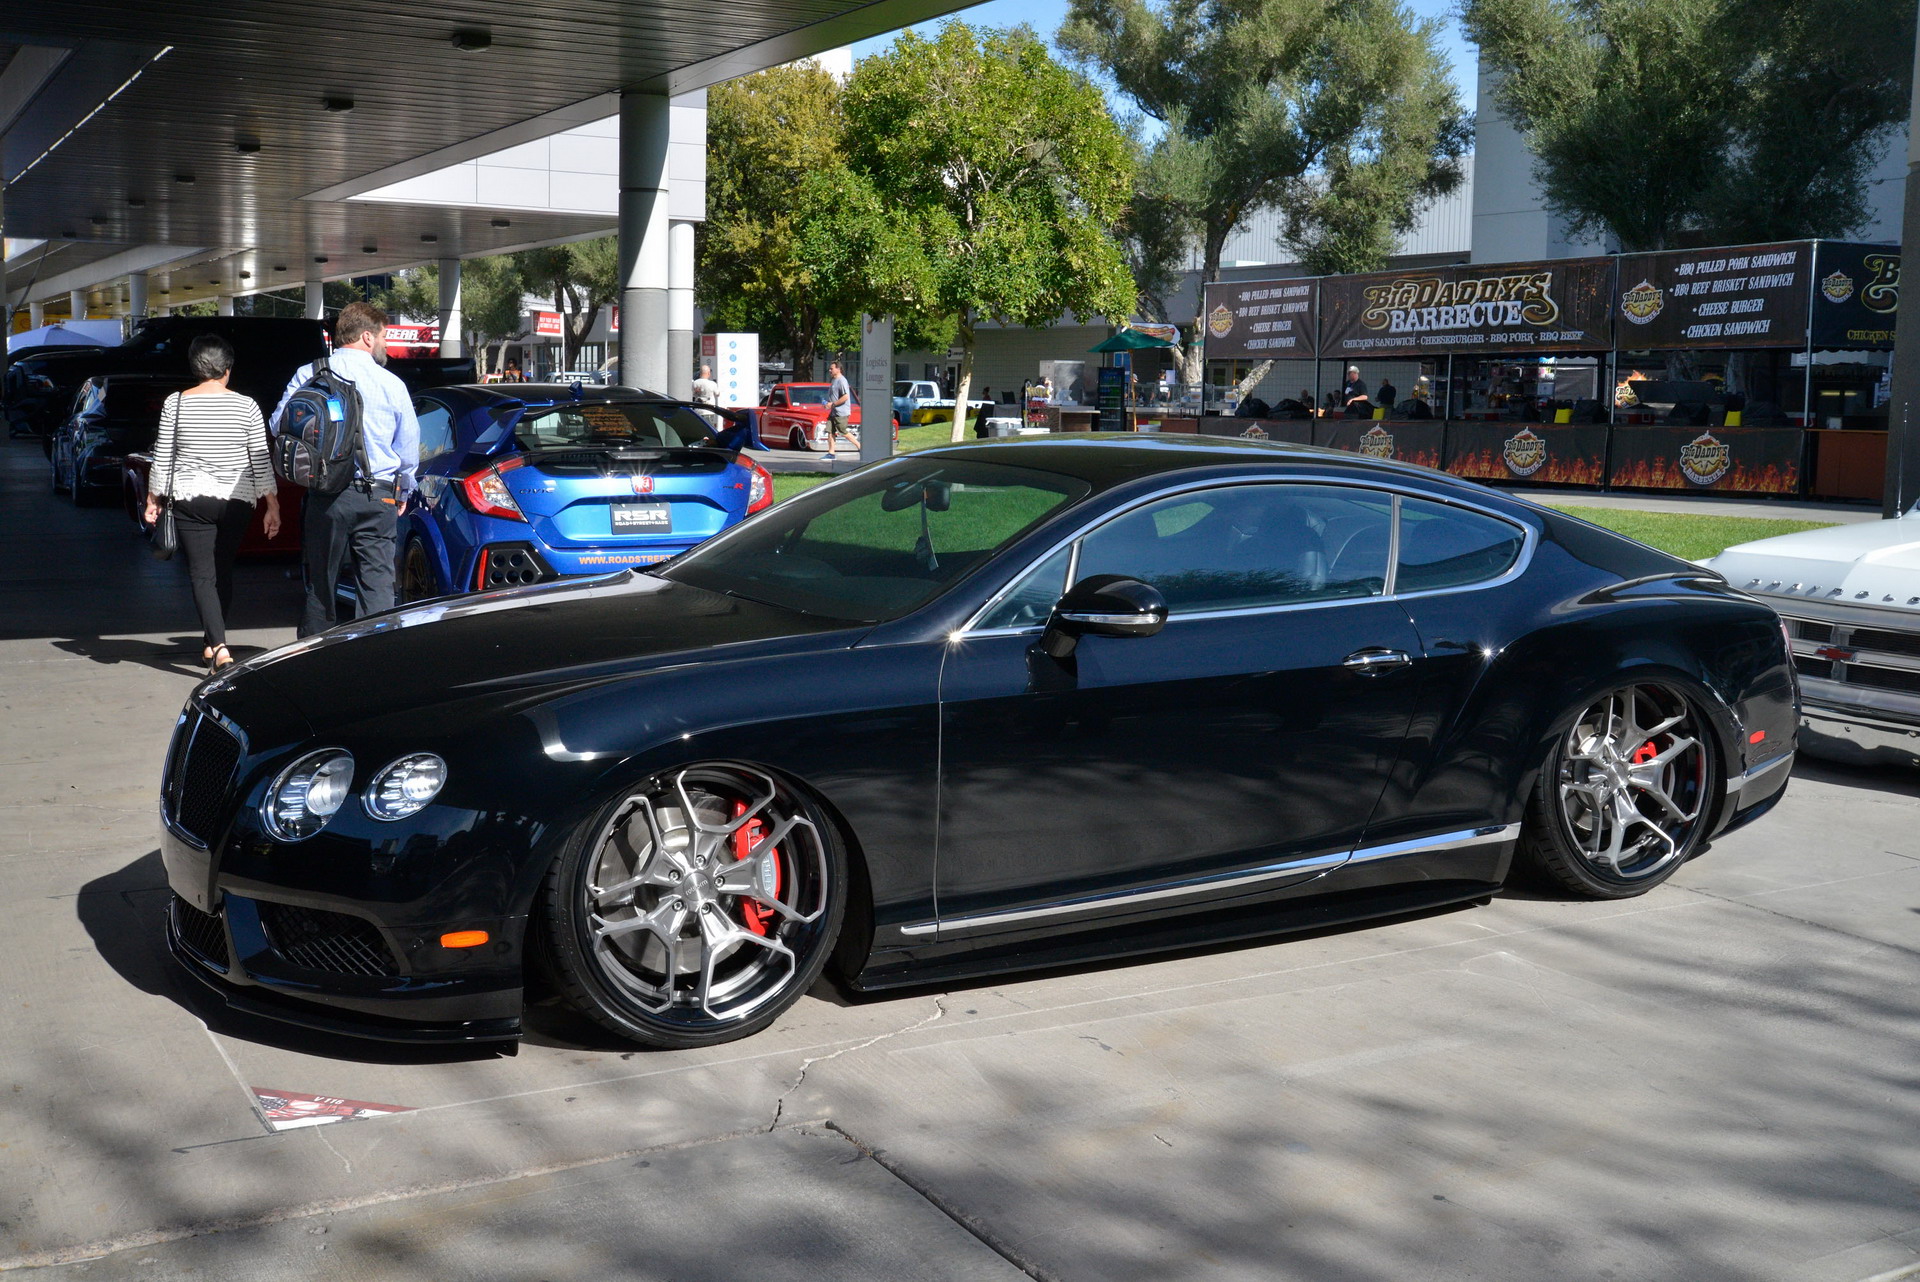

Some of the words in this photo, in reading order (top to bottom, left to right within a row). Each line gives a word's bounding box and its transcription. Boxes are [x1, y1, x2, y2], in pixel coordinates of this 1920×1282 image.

[1679, 262, 1694, 276] BBQ
[1696, 259, 1727, 274] PULLED
[1727, 256, 1751, 271] PORK
[1751, 251, 1797, 268] SANDWICH
[1251, 289, 1269, 300] PULLED
[1269, 288, 1283, 299] PORK
[1283, 285, 1310, 297] SANDWICH
[1674, 282, 1690, 297] BBQ
[1691, 281, 1711, 295] BEEF
[1712, 277, 1748, 294] BRISKET
[1748, 272, 1795, 290] SANDWICH
[1282, 301, 1309, 313] SANDWICH
[1698, 302, 1729, 316] CHEESE
[1730, 298, 1764, 314] BURGER
[1389, 300, 1523, 333] BARBECUE
[1253, 322, 1272, 333] CHEESE
[1272, 320, 1292, 332] BURGER
[1687, 323, 1723, 338] CHICKEN
[1724, 319, 1771, 335] SANDWICH
[1247, 339, 1268, 350] CHICKEN
[1268, 336, 1296, 348] SANDWICH
[1343, 338, 1374, 350] CHICKEN
[1375, 335, 1416, 347] SANDWICH
[1421, 334, 1484, 345] CHEESEBURGER
[1490, 333, 1508, 343] BBQ
[1509, 332, 1534, 345] PORK
[1540, 331, 1559, 342] BBQ
[1560, 330, 1584, 341] BEEF
[1847, 329, 1888, 344] CHICKEN
[613, 510, 668, 521] RSR
